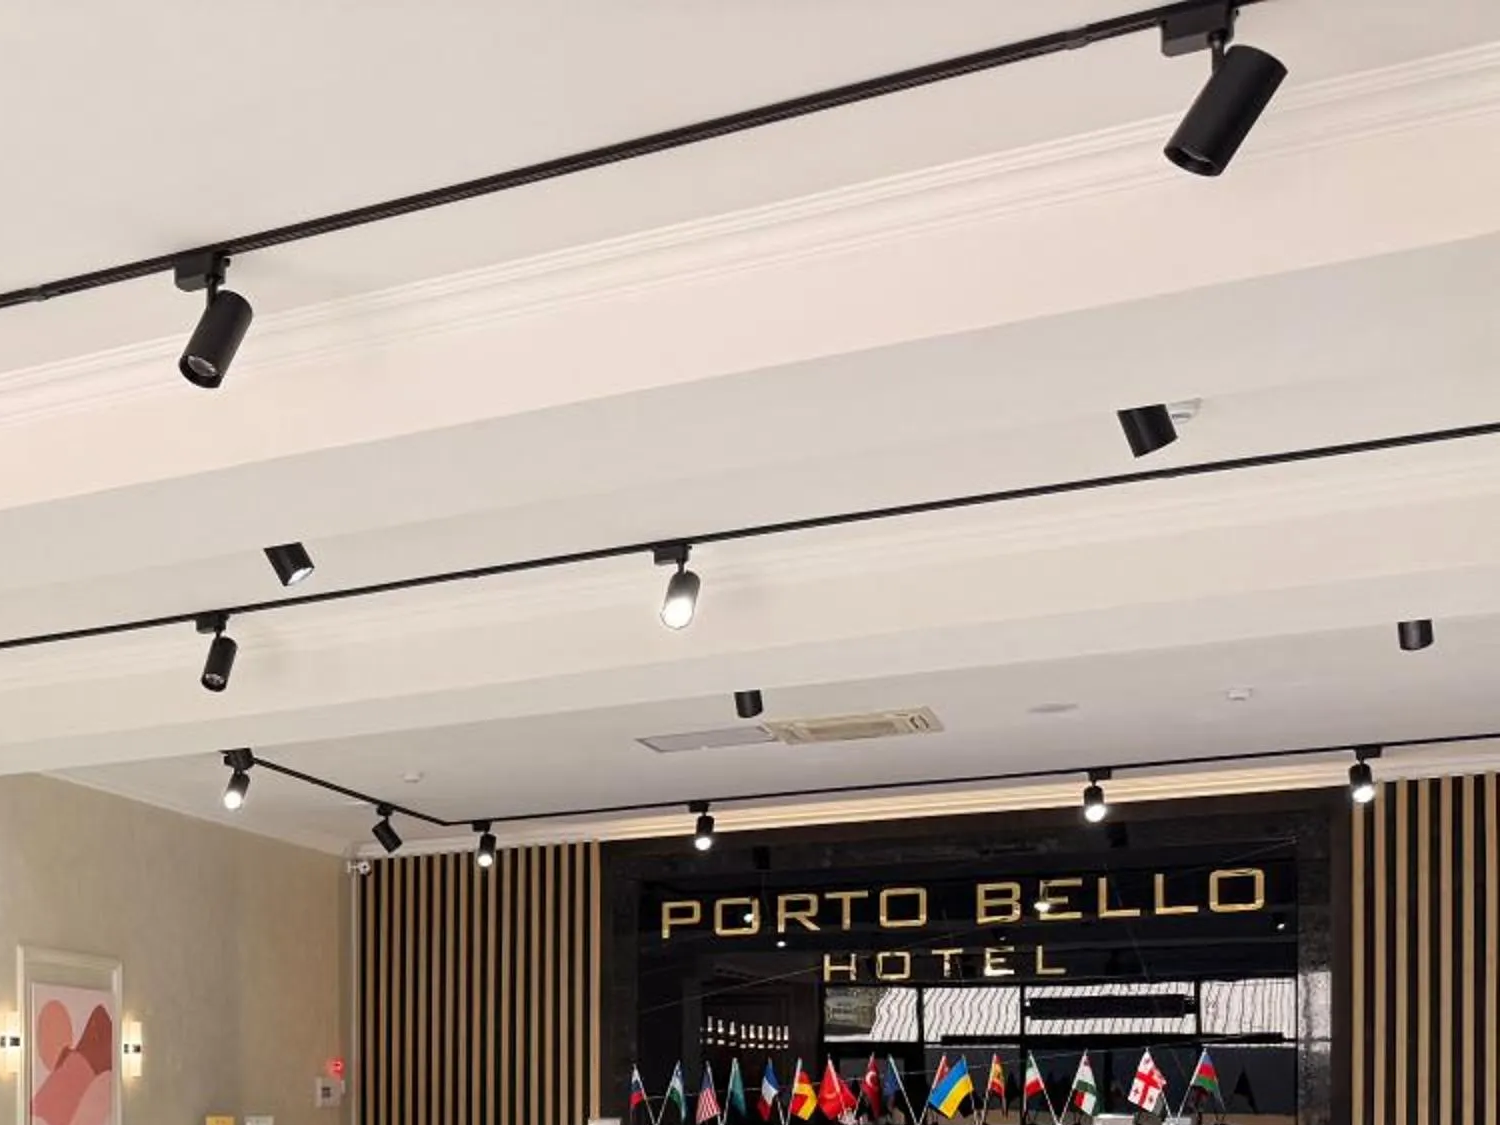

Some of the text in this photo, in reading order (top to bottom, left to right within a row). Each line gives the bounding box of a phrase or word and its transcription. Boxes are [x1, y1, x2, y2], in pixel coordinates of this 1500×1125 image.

[661, 868, 1266, 939] PORTO BELLO
[823, 945, 1067, 982] HOTEL
